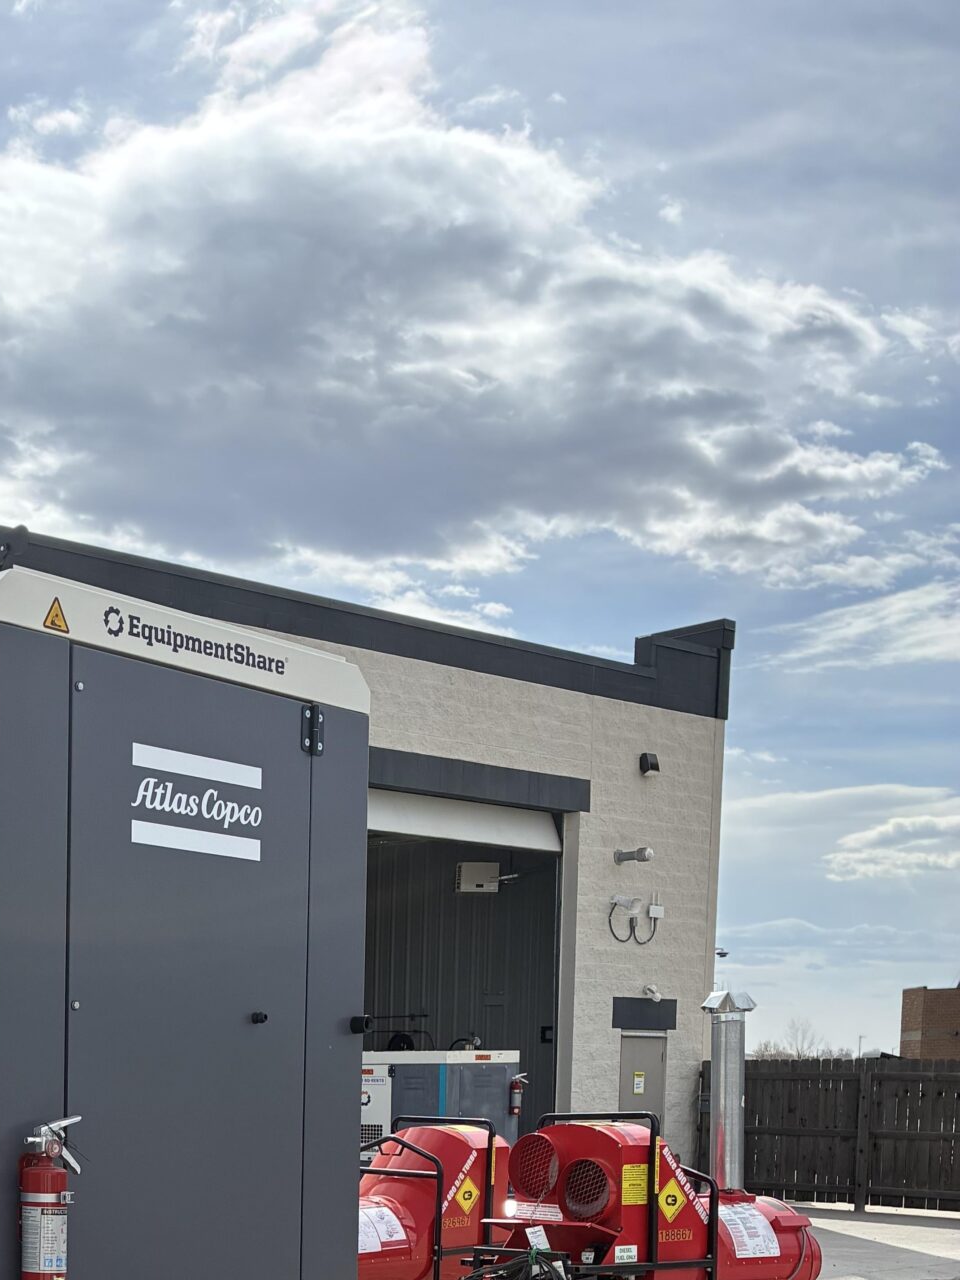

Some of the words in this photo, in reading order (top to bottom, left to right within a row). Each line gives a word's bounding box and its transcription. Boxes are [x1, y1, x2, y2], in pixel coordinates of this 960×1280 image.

[128, 614, 285, 675] EquipmentShare
[131, 777, 199, 817] Atlas
[201, 788, 262, 829] Copco
[447, 1186, 457, 1201] 400
[462, 1150, 477, 1174] TURBO
[662, 1145, 677, 1170] Blaze
[675, 1167, 687, 1186] 400
[683, 1183, 696, 1201] D/G
[693, 1197, 709, 1225] TURBO
[660, 1229, 692, 1241] 188667
